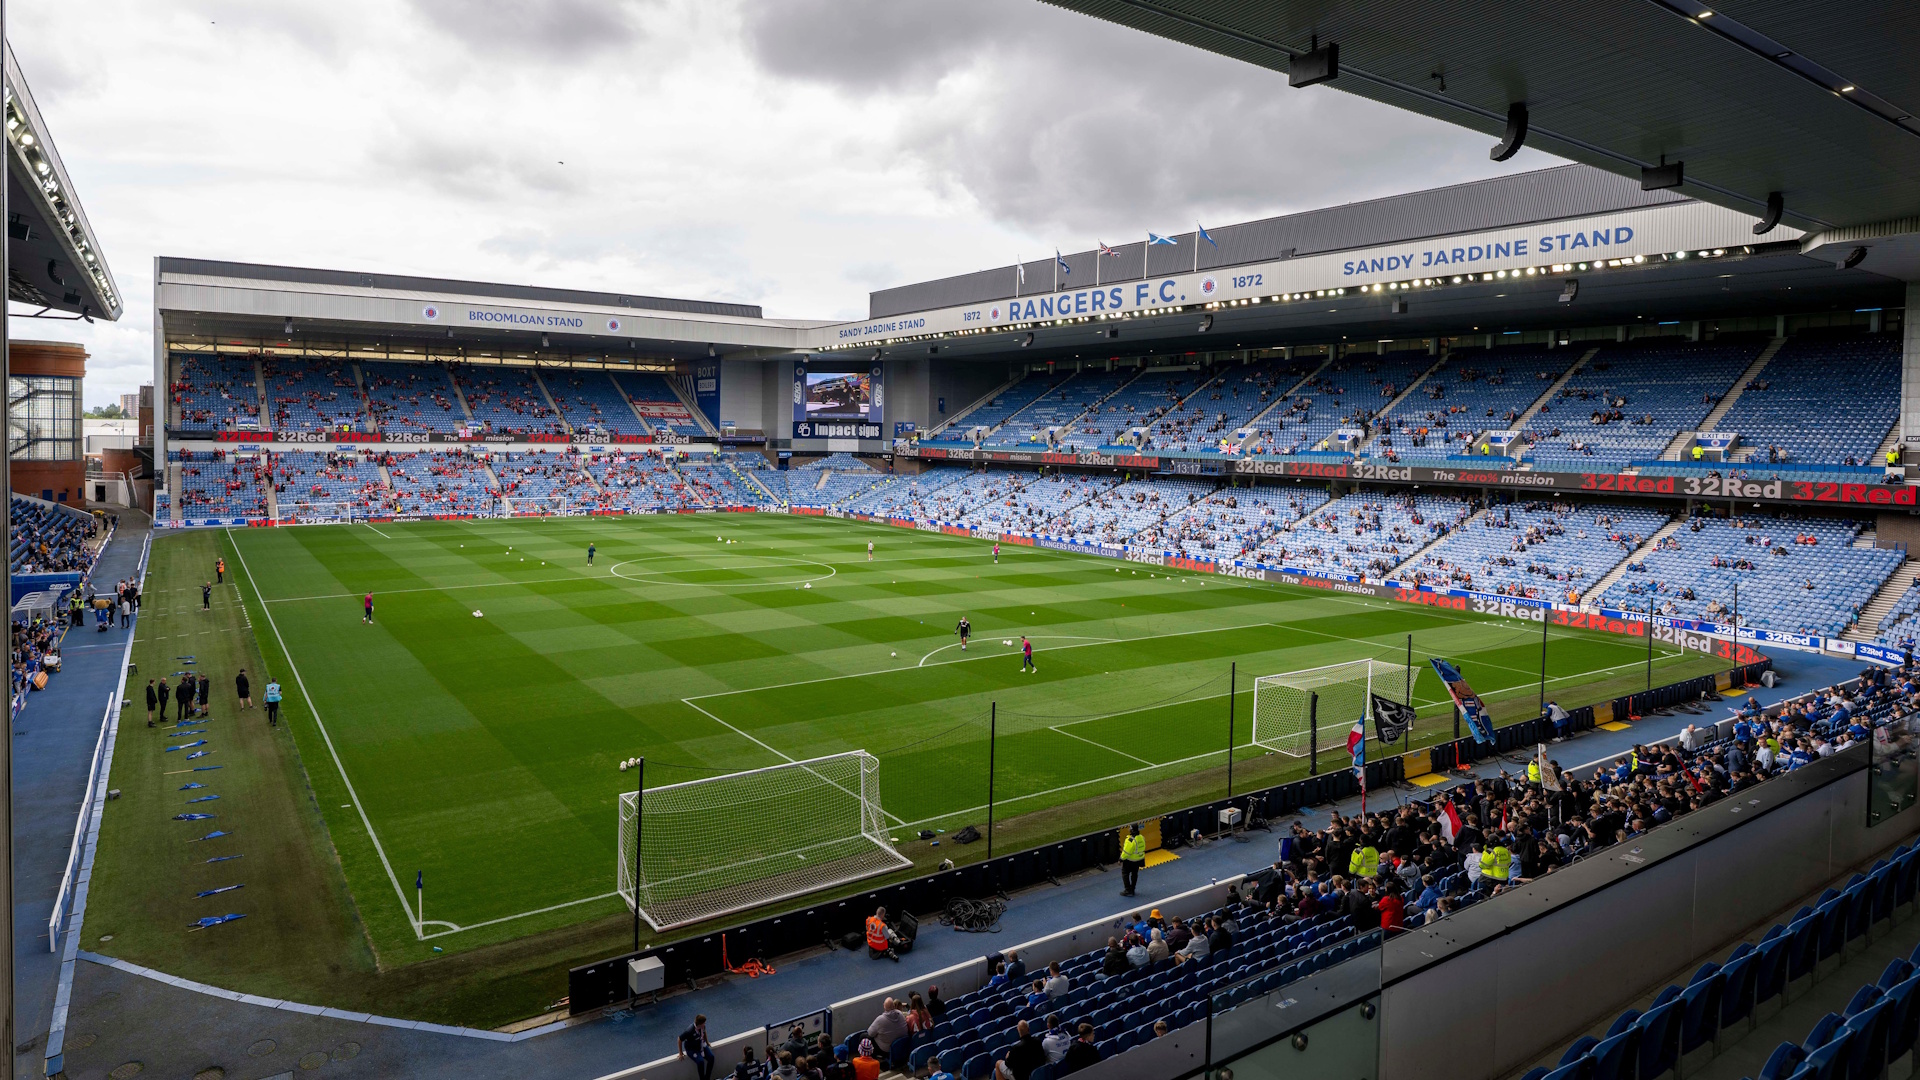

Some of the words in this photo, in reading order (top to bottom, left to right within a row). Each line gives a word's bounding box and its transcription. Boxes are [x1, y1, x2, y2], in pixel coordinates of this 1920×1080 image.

[1344, 254, 1415, 276] SANDY
[1422, 239, 1528, 267] JARDINE
[1539, 226, 1634, 252] STAND
[1233, 274, 1263, 288] 1872
[1009, 287, 1123, 321] RANGERS
[1136, 280, 1186, 306] F.C.
[469, 311, 545, 326] BROOMLOAN
[547, 316, 583, 328] STAND
[963, 311, 981, 321] 1872
[839, 327, 862, 339] SANDY
[864, 322, 896, 335] JARDINE
[898, 318, 925, 330] STAND
[697, 366, 716, 378] BOXT
[874, 383, 883, 407] SEKO
[217, 431, 273, 443] 32Red
[277, 431, 326, 443] 32Red
[331, 432, 381, 443] 32Red
[385, 432, 430, 443] 32Red
[443, 434, 458, 442] The
[527, 433, 570, 443] 32Red
[573, 434, 610, 444] 32Red
[613, 434, 652, 444] 32Red
[655, 434, 689, 444] 32Red
[814, 423, 856, 437] Impact
[858, 423, 880, 438] signs
[896, 447, 918, 457] 32Red
[920, 448, 947, 458] 32Red
[948, 449, 974, 460] 32Red
[1010, 453, 1032, 461] mission
[1041, 452, 1076, 465] 32Red
[1080, 453, 1114, 466] 32Red
[1117, 455, 1159, 468] 32Red
[1177, 463, 1200, 474] 13:17
[1235, 460, 1284, 475] 32Red
[1289, 462, 1347, 478] 32Red
[1352, 464, 1412, 481] 32Red
[1432, 470, 1455, 481] The
[1458, 471, 1498, 484] Zero%
[1501, 473, 1555, 486] mission
[1580, 473, 1674, 494] 32Red
[1683, 477, 1782, 500] 32Red
[1792, 480, 1917, 506] 32Red
[757, 505, 789, 514] 32Red
[791, 506, 824, 516] 32Red
[825, 508, 844, 519] 32Red
[890, 517, 915, 529] 32Red
[916, 521, 940, 533] 32Red
[941, 525, 970, 538] 32Red
[971, 529, 999, 541] 32Red
[1001, 533, 1034, 547] 32Red
[1041, 540, 1067, 550] RANGERS
[1068, 544, 1100, 555] FOOTBALL
[1100, 548, 1118, 558] CLUB
[1125, 550, 1164, 566] 32Red
[1168, 556, 1215, 573] 32Red
[1218, 563, 1265, 581] 32Red
[1281, 574, 1300, 584] The
[1301, 577, 1332, 589] Zero%
[1334, 582, 1376, 596] mission
[1327, 573, 1348, 582] IBROX
[1478, 593, 1517, 605] EDMISTON
[1517, 599, 1544, 609] HOUSE
[1394, 587, 1466, 611] 32Red
[1472, 598, 1545, 623] 32Red
[1552, 609, 1644, 637] 32Red
[1621, 612, 1671, 627] RANGERS
[1672, 620, 1685, 628] TV
[1651, 623, 1711, 654] 32Red
[1714, 624, 1757, 639] 32Red
[1765, 631, 1810, 646] 32Red
[1860, 646, 1883, 658] 32Red
[1886, 651, 1904, 662] 32Re
